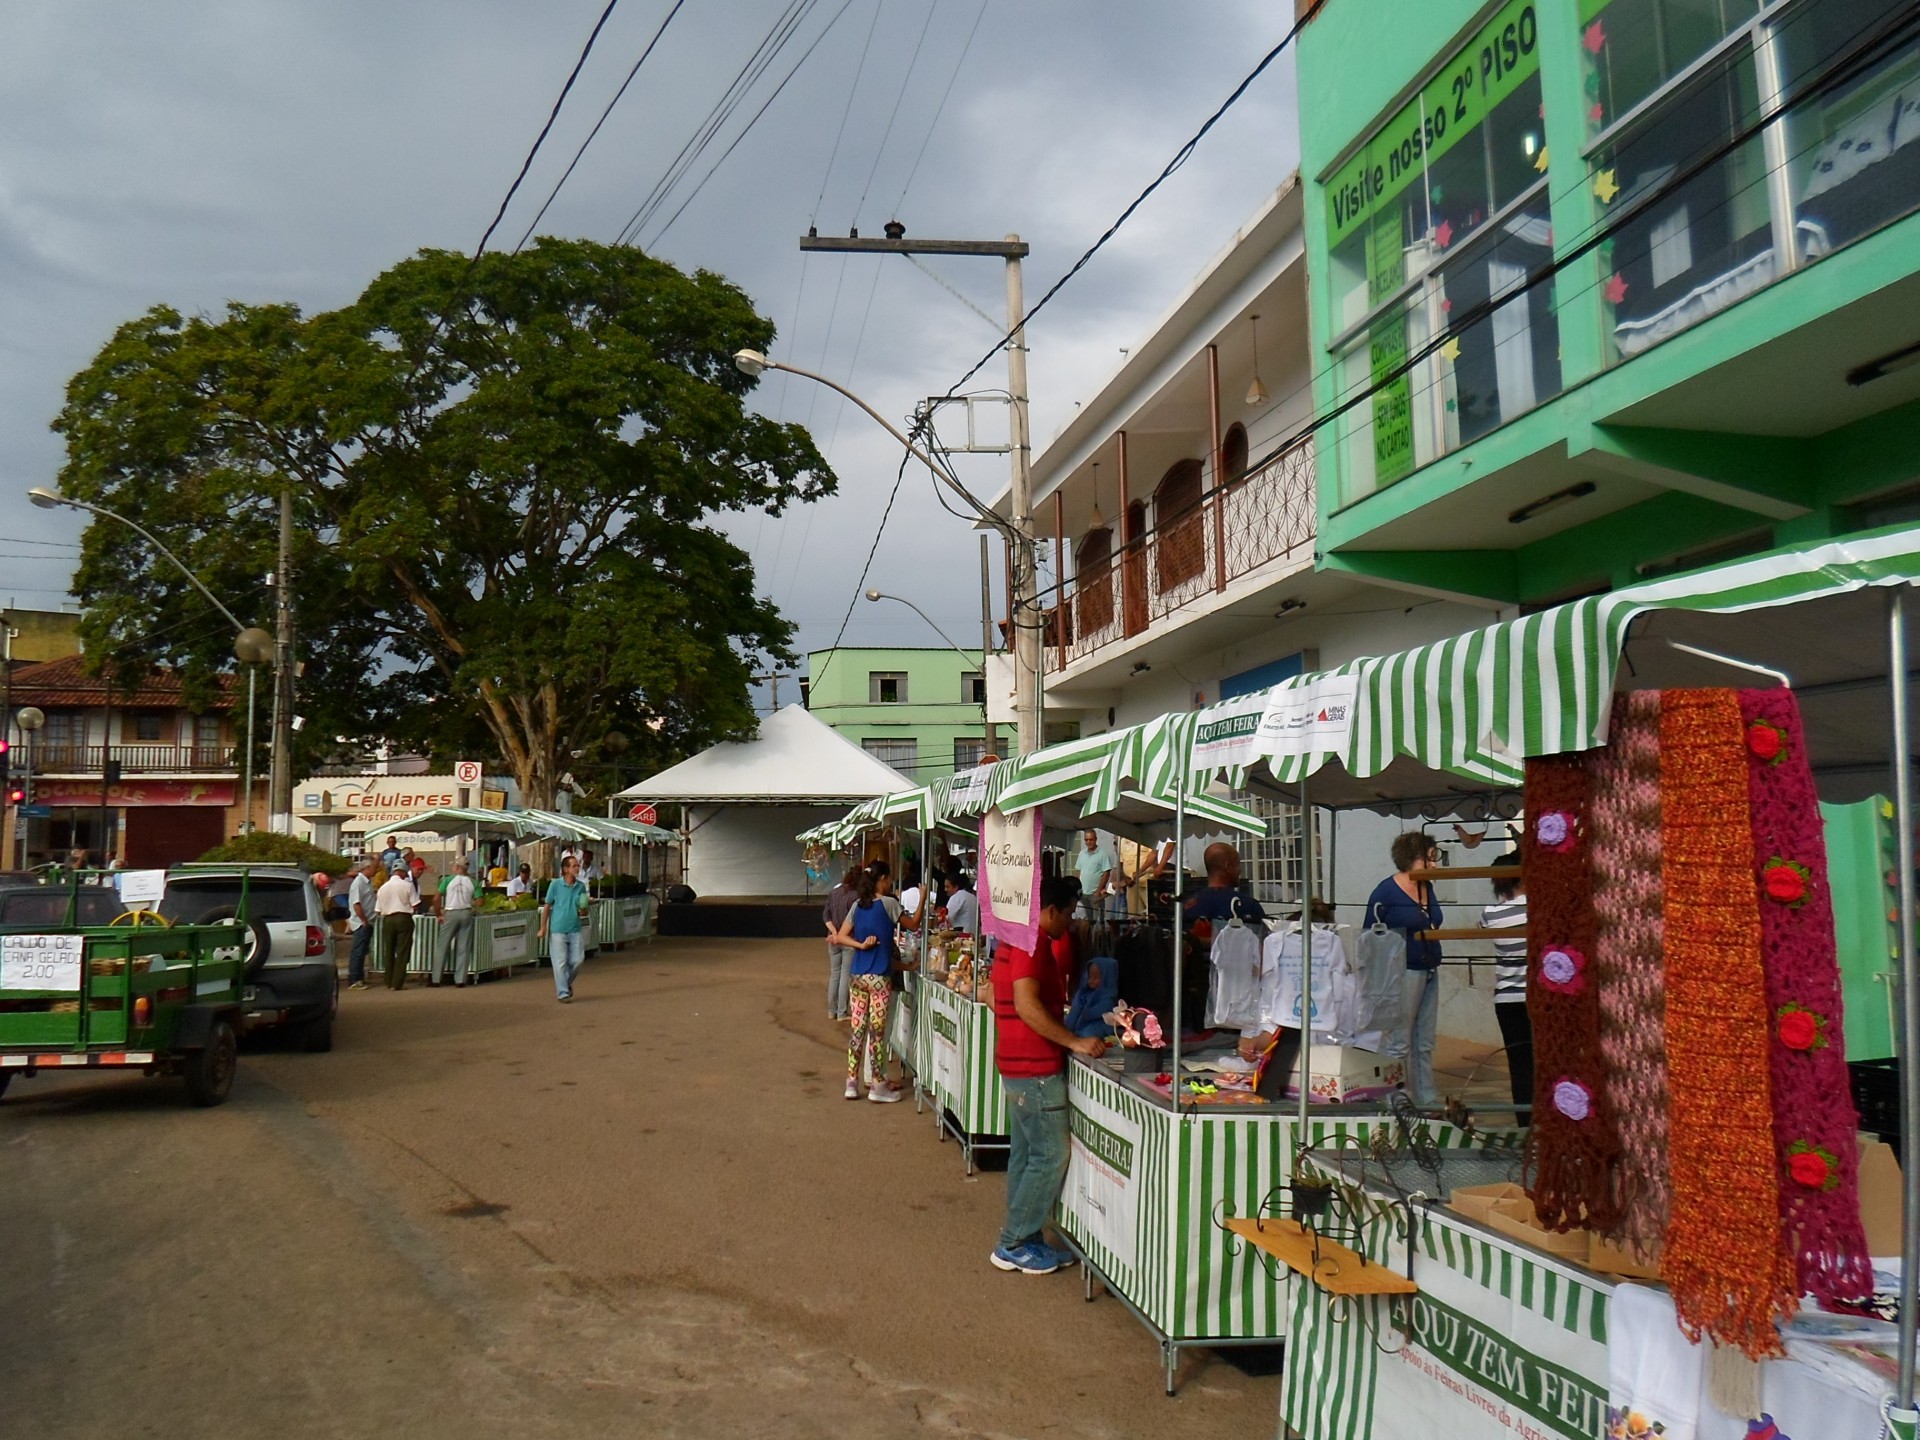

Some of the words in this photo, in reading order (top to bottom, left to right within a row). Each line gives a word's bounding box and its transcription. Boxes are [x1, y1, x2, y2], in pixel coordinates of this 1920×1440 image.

[1332, 164, 1384, 229] Visite
[1389, 105, 1446, 183] nosso
[1480, 5, 1537, 96] PISO
[346, 792, 453, 807] Celulares
[351, 812, 410, 822] ssistência
[55, 936, 73, 950] DE
[3, 951, 33, 963] CANA
[39, 951, 81, 965] GELADO
[22, 964, 55, 979] 2.00
[1099, 1131, 1132, 1172] FEIRA!
[1392, 1294, 1461, 1357] AQUI
[1463, 1325, 1530, 1400] TEM
[1434, 1364, 1464, 1396] Feiras
[1465, 1384, 1497, 1419] Livres
[1498, 1404, 1511, 1429] da
